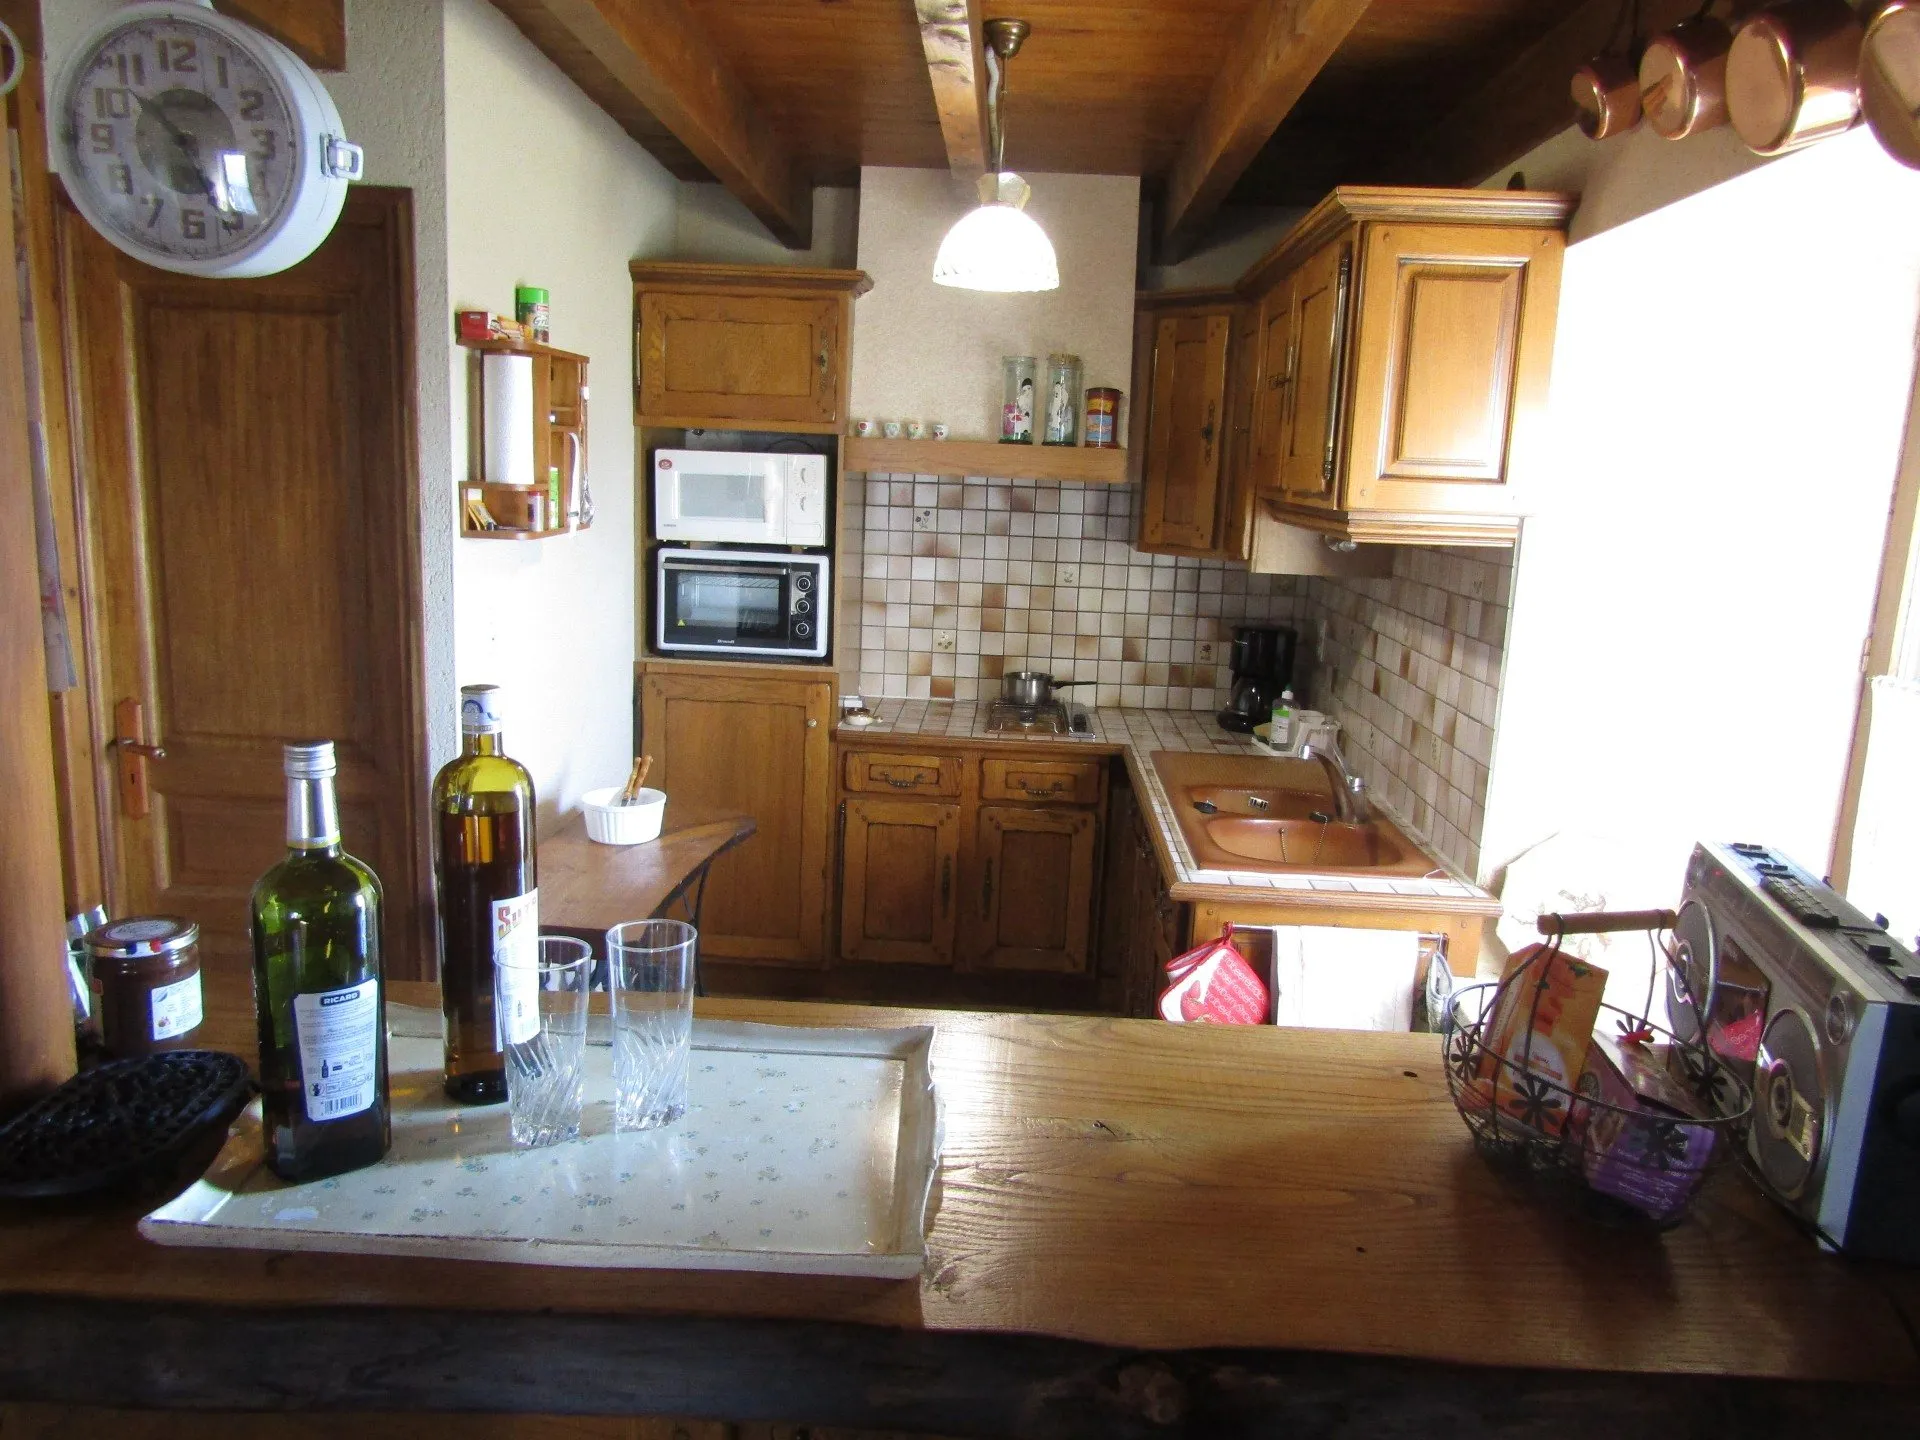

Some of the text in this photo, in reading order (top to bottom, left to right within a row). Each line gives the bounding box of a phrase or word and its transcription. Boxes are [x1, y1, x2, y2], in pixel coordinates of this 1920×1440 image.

[117, 53, 144, 86] 11
[157, 38, 198, 72] 12
[216, 54, 228, 88] 1
[94, 88, 131, 118] 10
[239, 90, 264, 121] 2
[91, 124, 115, 154] 9
[250, 129, 276, 160] 3
[108, 164, 133, 195] 8
[140, 198, 164, 228] 7
[181, 209, 206, 240] 6
[323, 992, 358, 1005] RICARD
